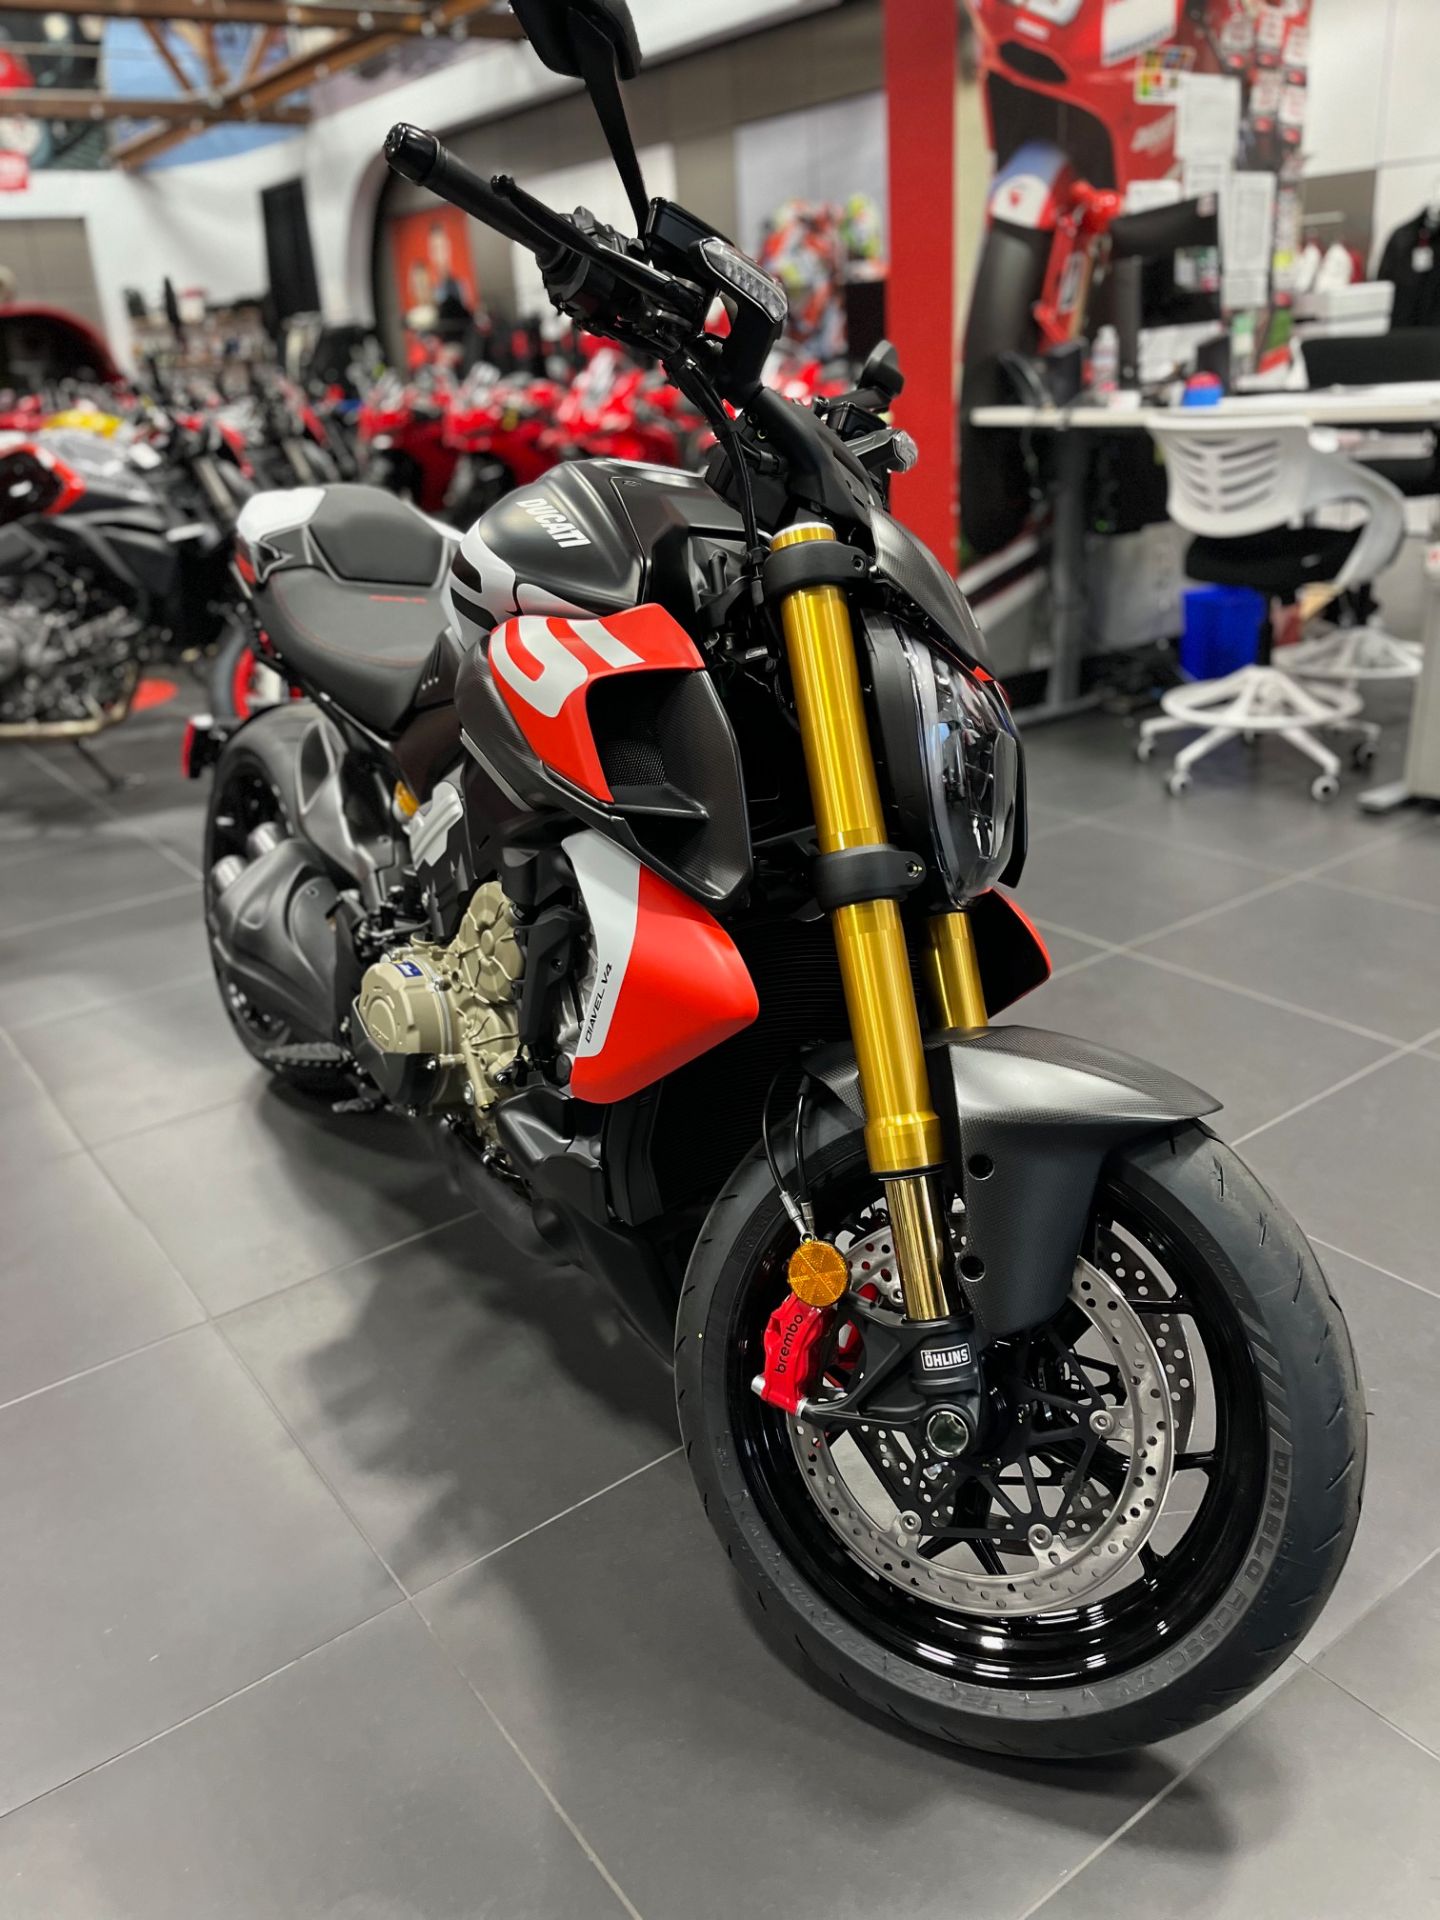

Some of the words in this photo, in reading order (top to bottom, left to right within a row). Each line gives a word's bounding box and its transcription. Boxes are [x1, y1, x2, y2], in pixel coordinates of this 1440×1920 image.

[515, 498, 592, 548] DUCATI
[585, 988, 606, 1043] DIAVEL
[601, 963, 612, 984] V4
[774, 1314, 803, 1374] brembo
[924, 1348, 969, 1367] ÖHLINS
[1244, 1451, 1290, 1586] DIABLO
[1168, 1588, 1247, 1674] ROSSO
